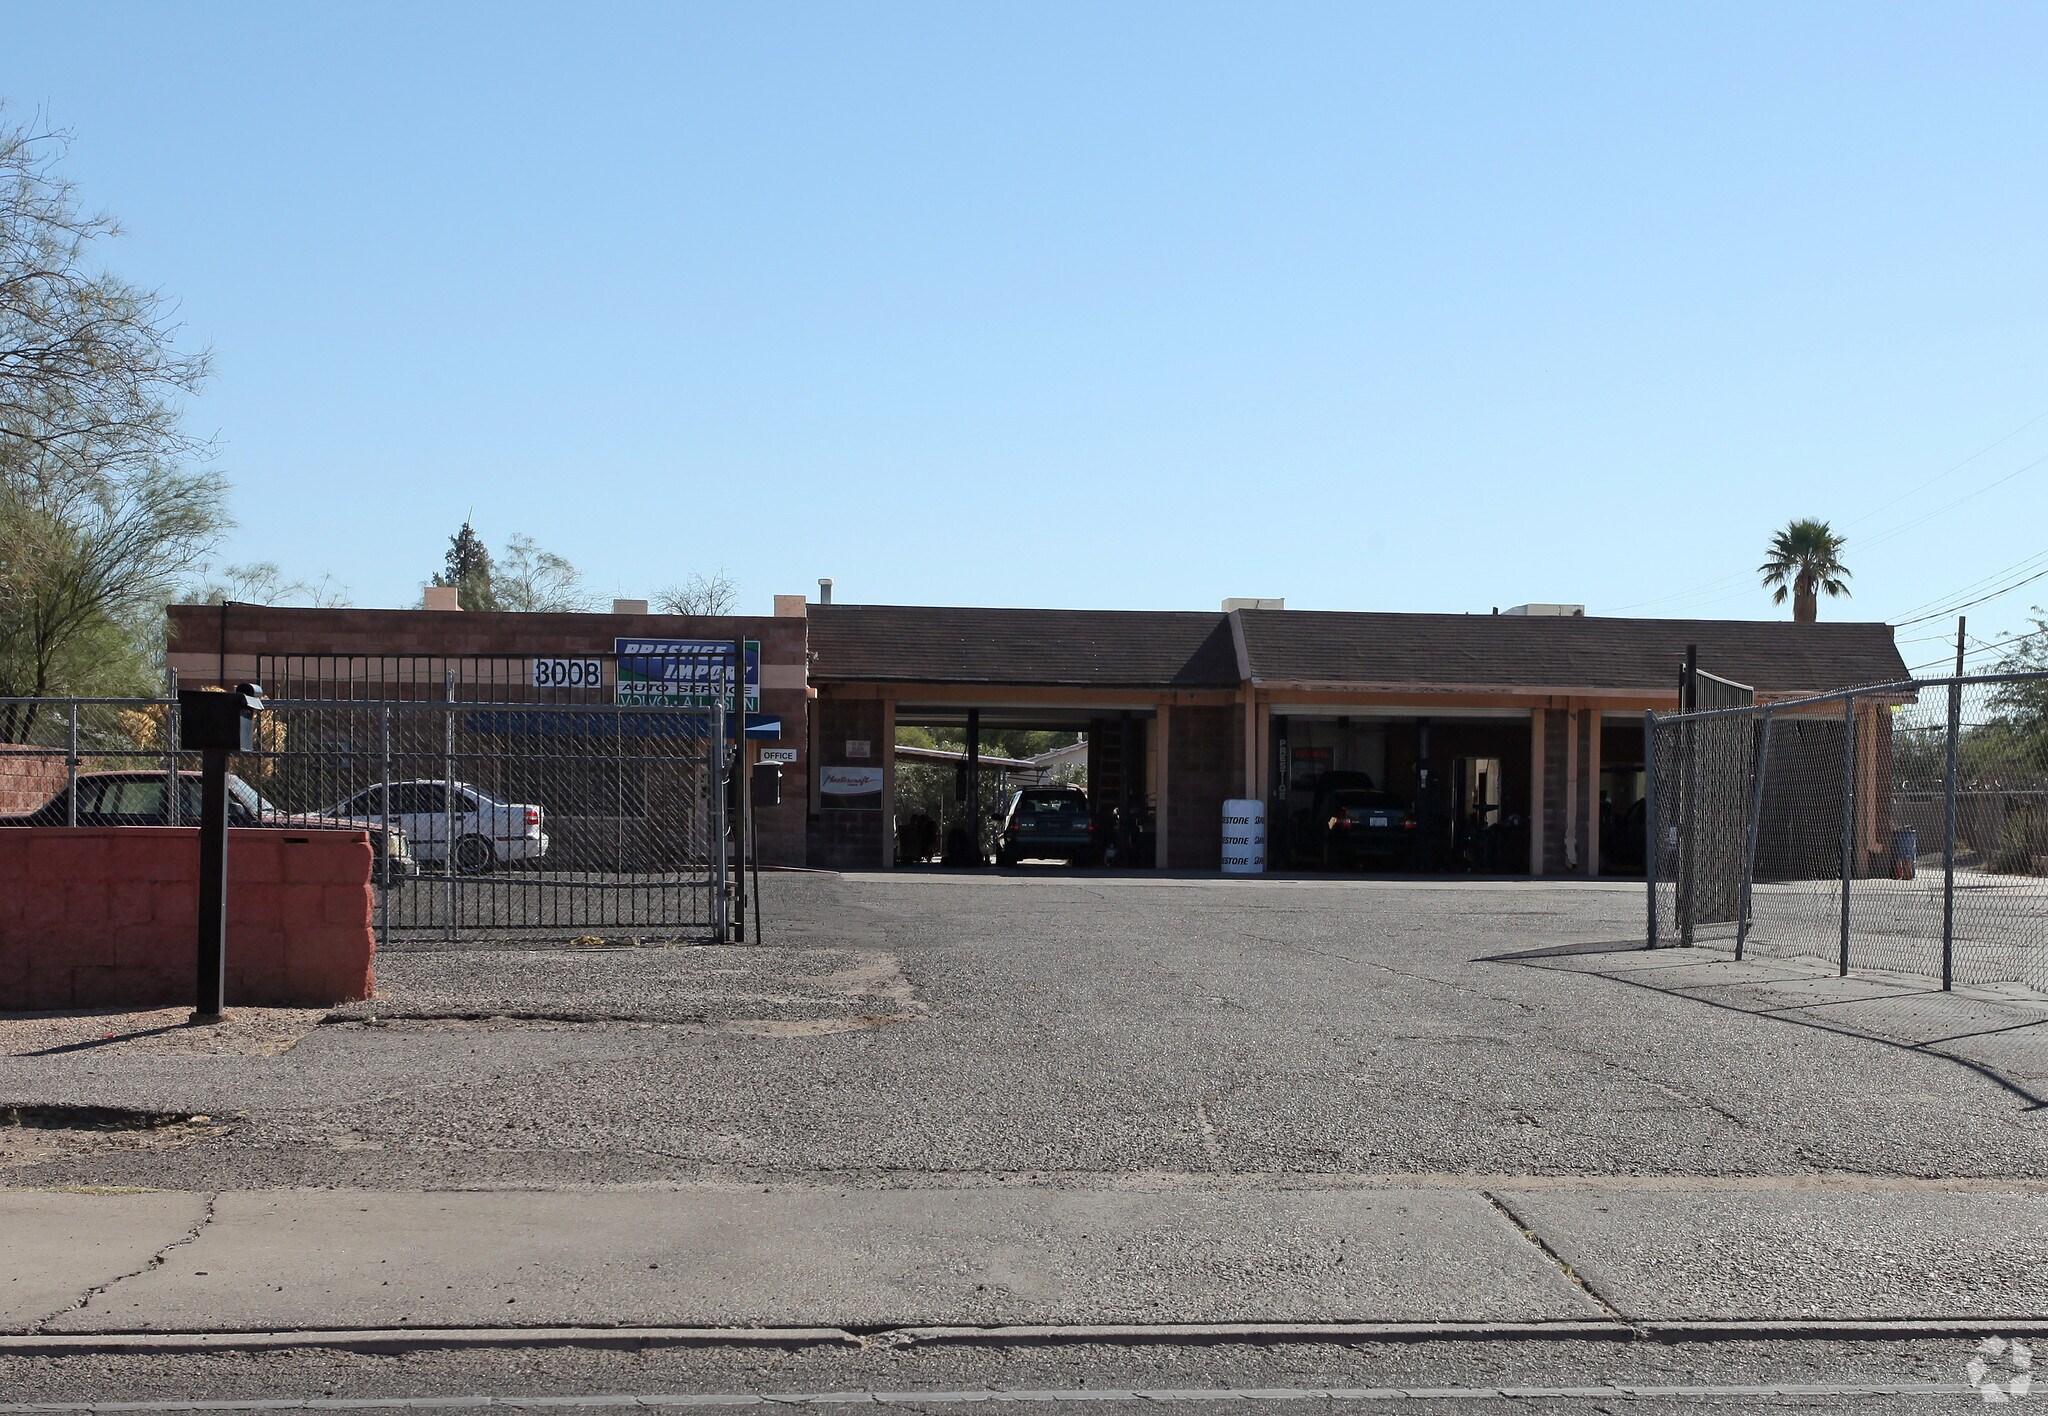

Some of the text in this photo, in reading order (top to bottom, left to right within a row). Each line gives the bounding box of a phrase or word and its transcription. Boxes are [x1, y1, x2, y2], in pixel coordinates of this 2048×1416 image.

[624, 643, 727, 660] PRESTIGE
[536, 661, 599, 685] 3008
[621, 683, 669, 692] AUTO
[620, 694, 669, 707] VOLVO
[763, 751, 793, 763] OFFICE
